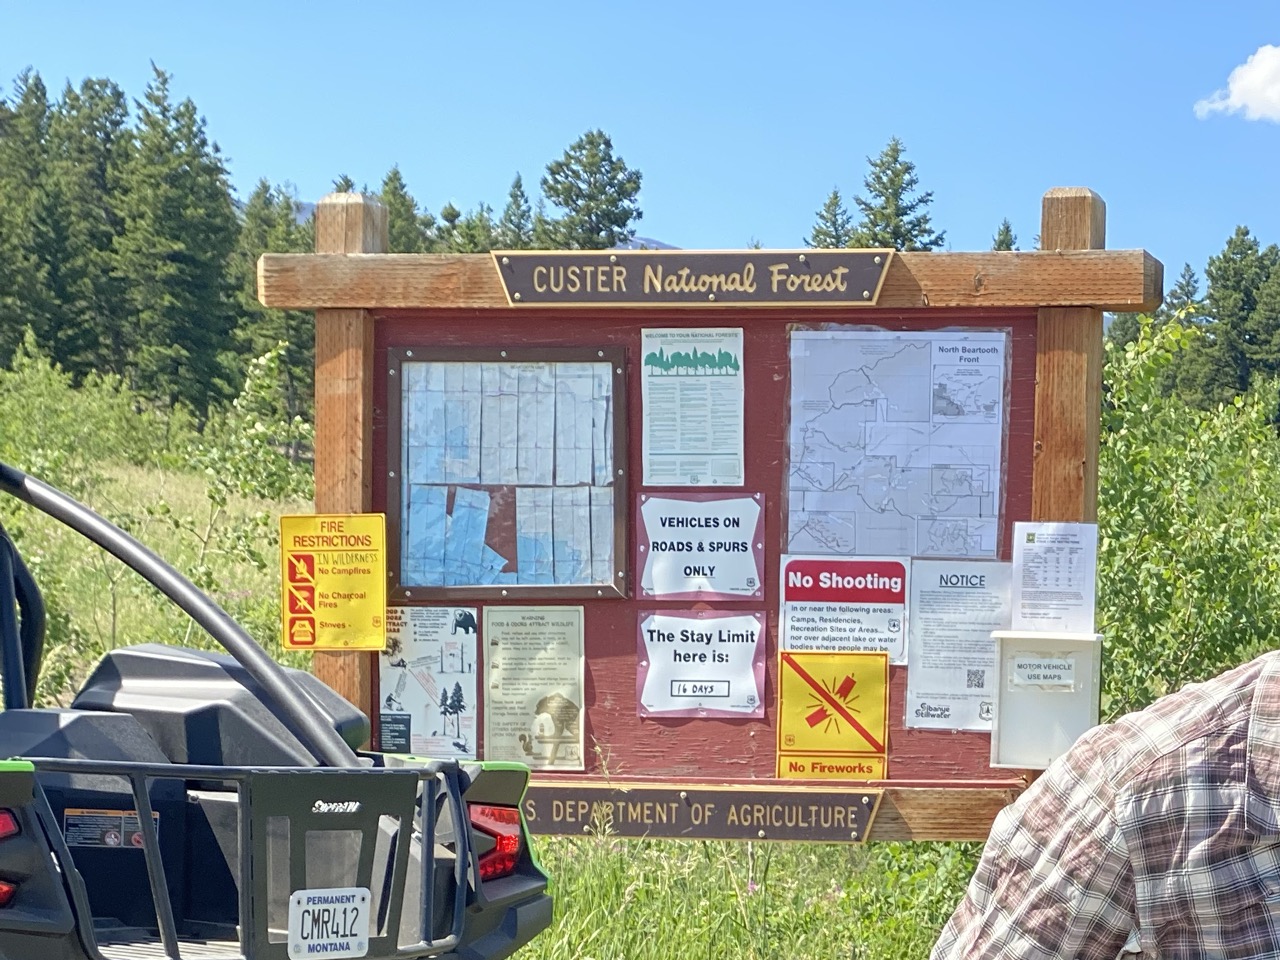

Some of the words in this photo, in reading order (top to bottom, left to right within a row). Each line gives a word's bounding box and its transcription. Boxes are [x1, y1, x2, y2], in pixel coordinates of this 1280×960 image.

[533, 265, 627, 293] CUSTER
[643, 262, 756, 293] National
[769, 263, 848, 293] Forest
[320, 521, 344, 532] FIRE
[660, 517, 720, 528] VEHICLES
[723, 517, 740, 528] ON
[293, 535, 372, 548] RESTRICTIONS
[652, 541, 692, 552] ROADS
[696, 542, 704, 552] &
[708, 542, 748, 552] SPURS
[316, 554, 329, 565] IN
[332, 553, 378, 565] WILDERNESS
[331, 567, 371, 576] Campfires
[684, 566, 716, 576] ONLY
[788, 572, 814, 588] No
[818, 572, 902, 592] Shooting
[940, 574, 986, 586] NOTICE
[318, 600, 338, 608] Fires
[839, 606, 870, 614] following
[790, 616, 818, 624] Camps,
[819, 616, 863, 624] Residencies,
[647, 629, 675, 642] The
[680, 630, 713, 645] Stay
[718, 630, 756, 643] Limit
[673, 650, 707, 662] here
[712, 650, 729, 662] is:
[678, 684, 688, 694] 16
[692, 684, 714, 694] DAYS
[920, 702, 950, 713] Sibanye
[915, 709, 951, 718] Stillwater
[788, 762, 806, 773] No
[811, 762, 873, 774] Fireworks
[552, 800, 680, 824] DEPARTMENT
[690, 803, 715, 824] OF
[727, 804, 858, 828] AGRICULTURE
[306, 894, 356, 905] PERMANENT
[300, 906, 359, 940] CMR412
[308, 942, 350, 954] MONTANA
